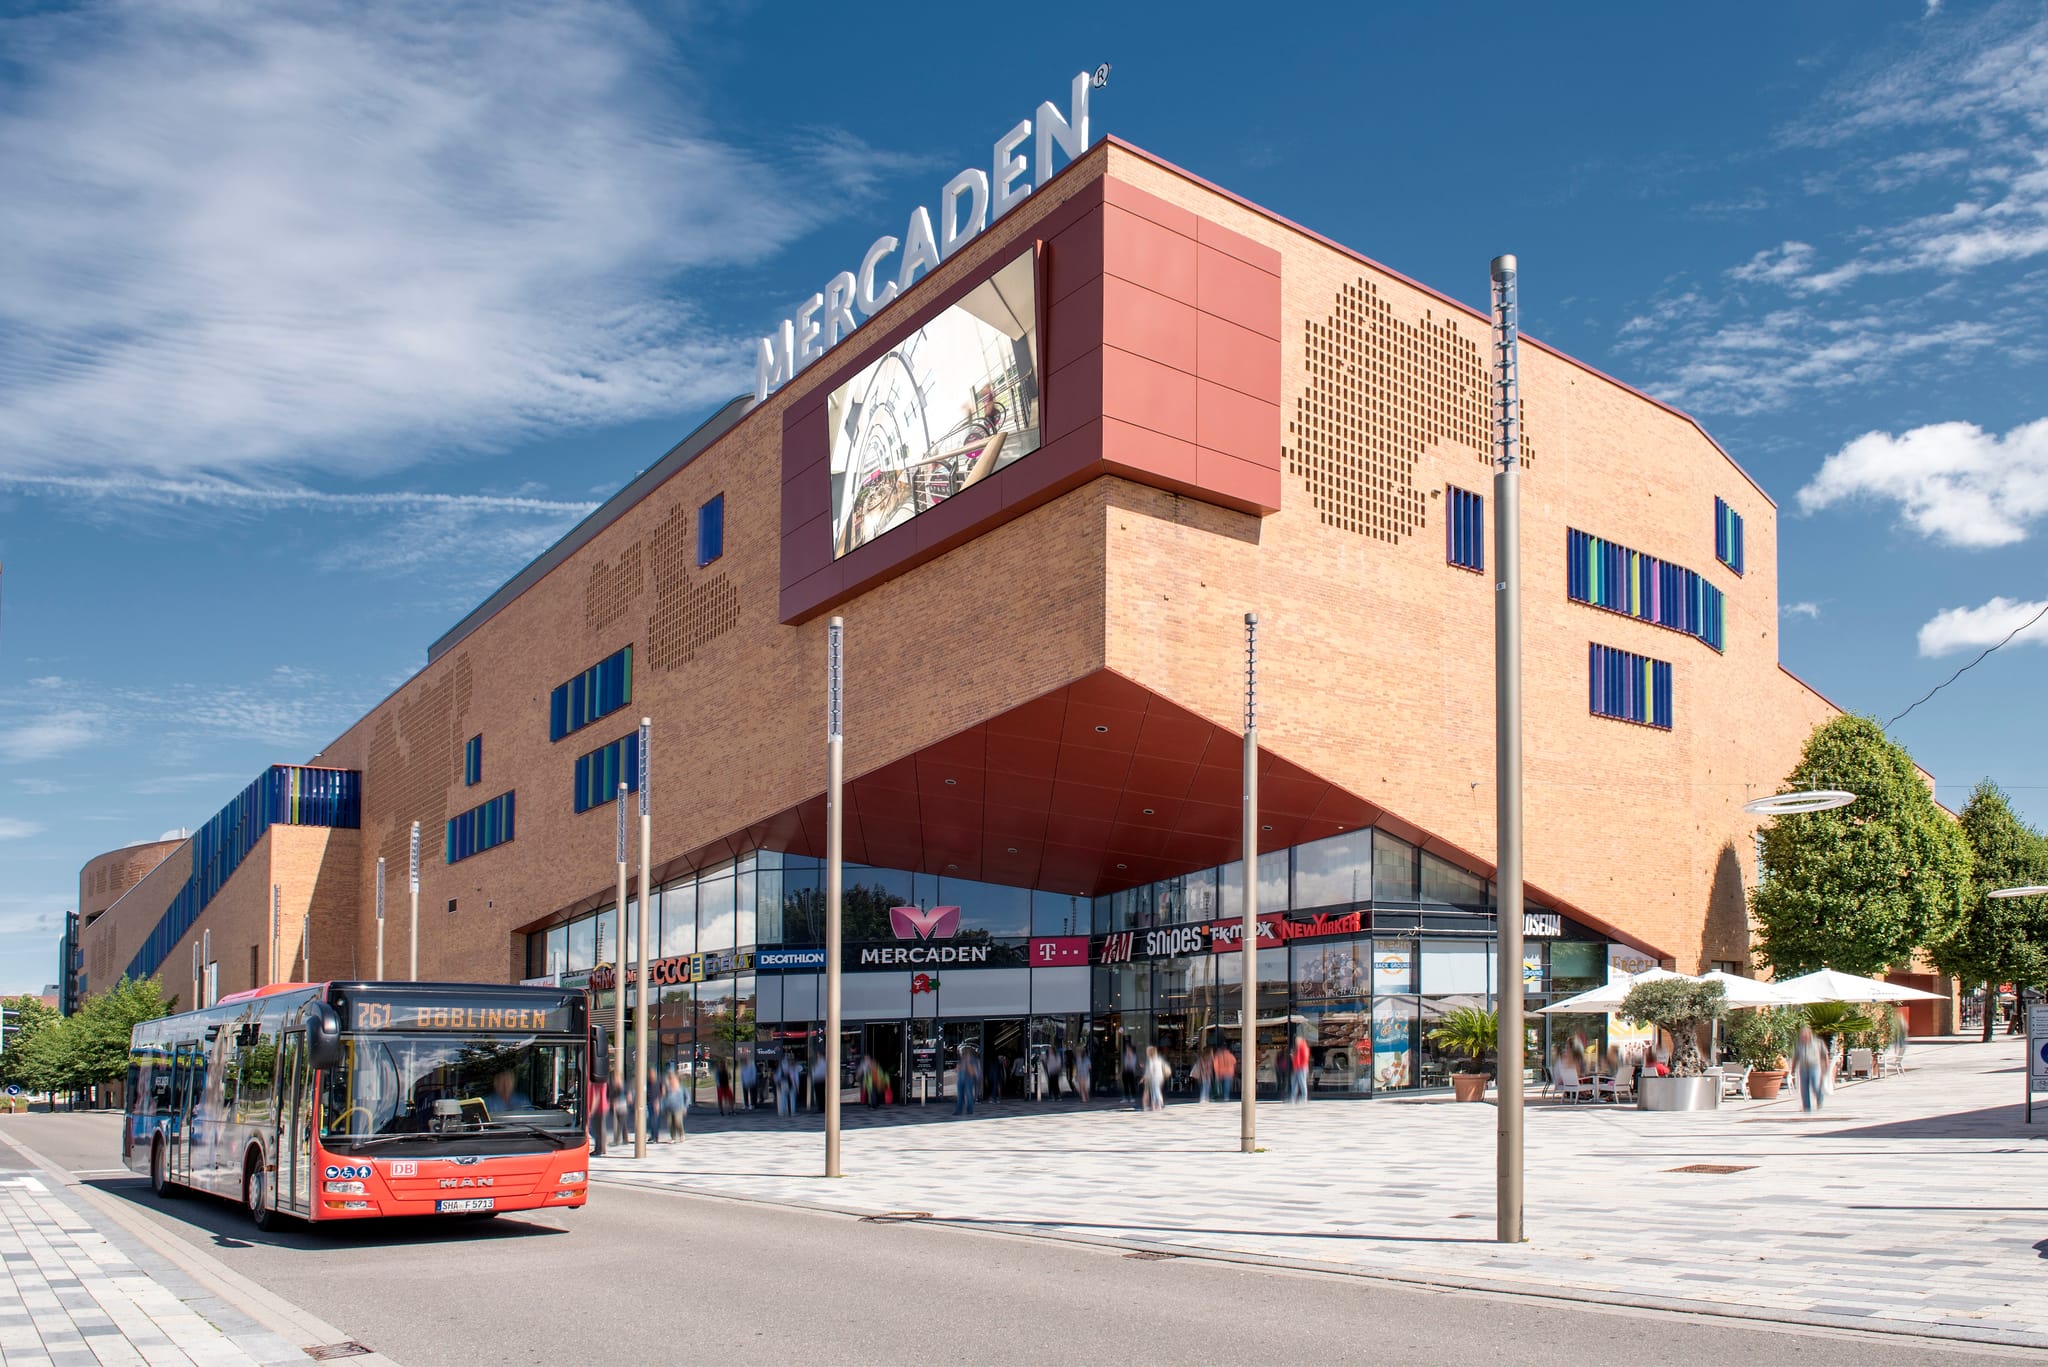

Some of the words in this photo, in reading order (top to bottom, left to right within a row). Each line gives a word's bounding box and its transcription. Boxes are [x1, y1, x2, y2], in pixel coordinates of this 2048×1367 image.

[1101, 931, 1134, 964] H&M
[1146, 925, 1202, 959] snipes
[704, 954, 747, 975] EDEKA
[760, 953, 825, 965] DECATHLON
[653, 955, 690, 985] CCC
[357, 1002, 391, 1028] 761
[394, 1164, 413, 1175] DB
[439, 1177, 494, 1189] MAN
[442, 1201, 458, 1210] SHA
